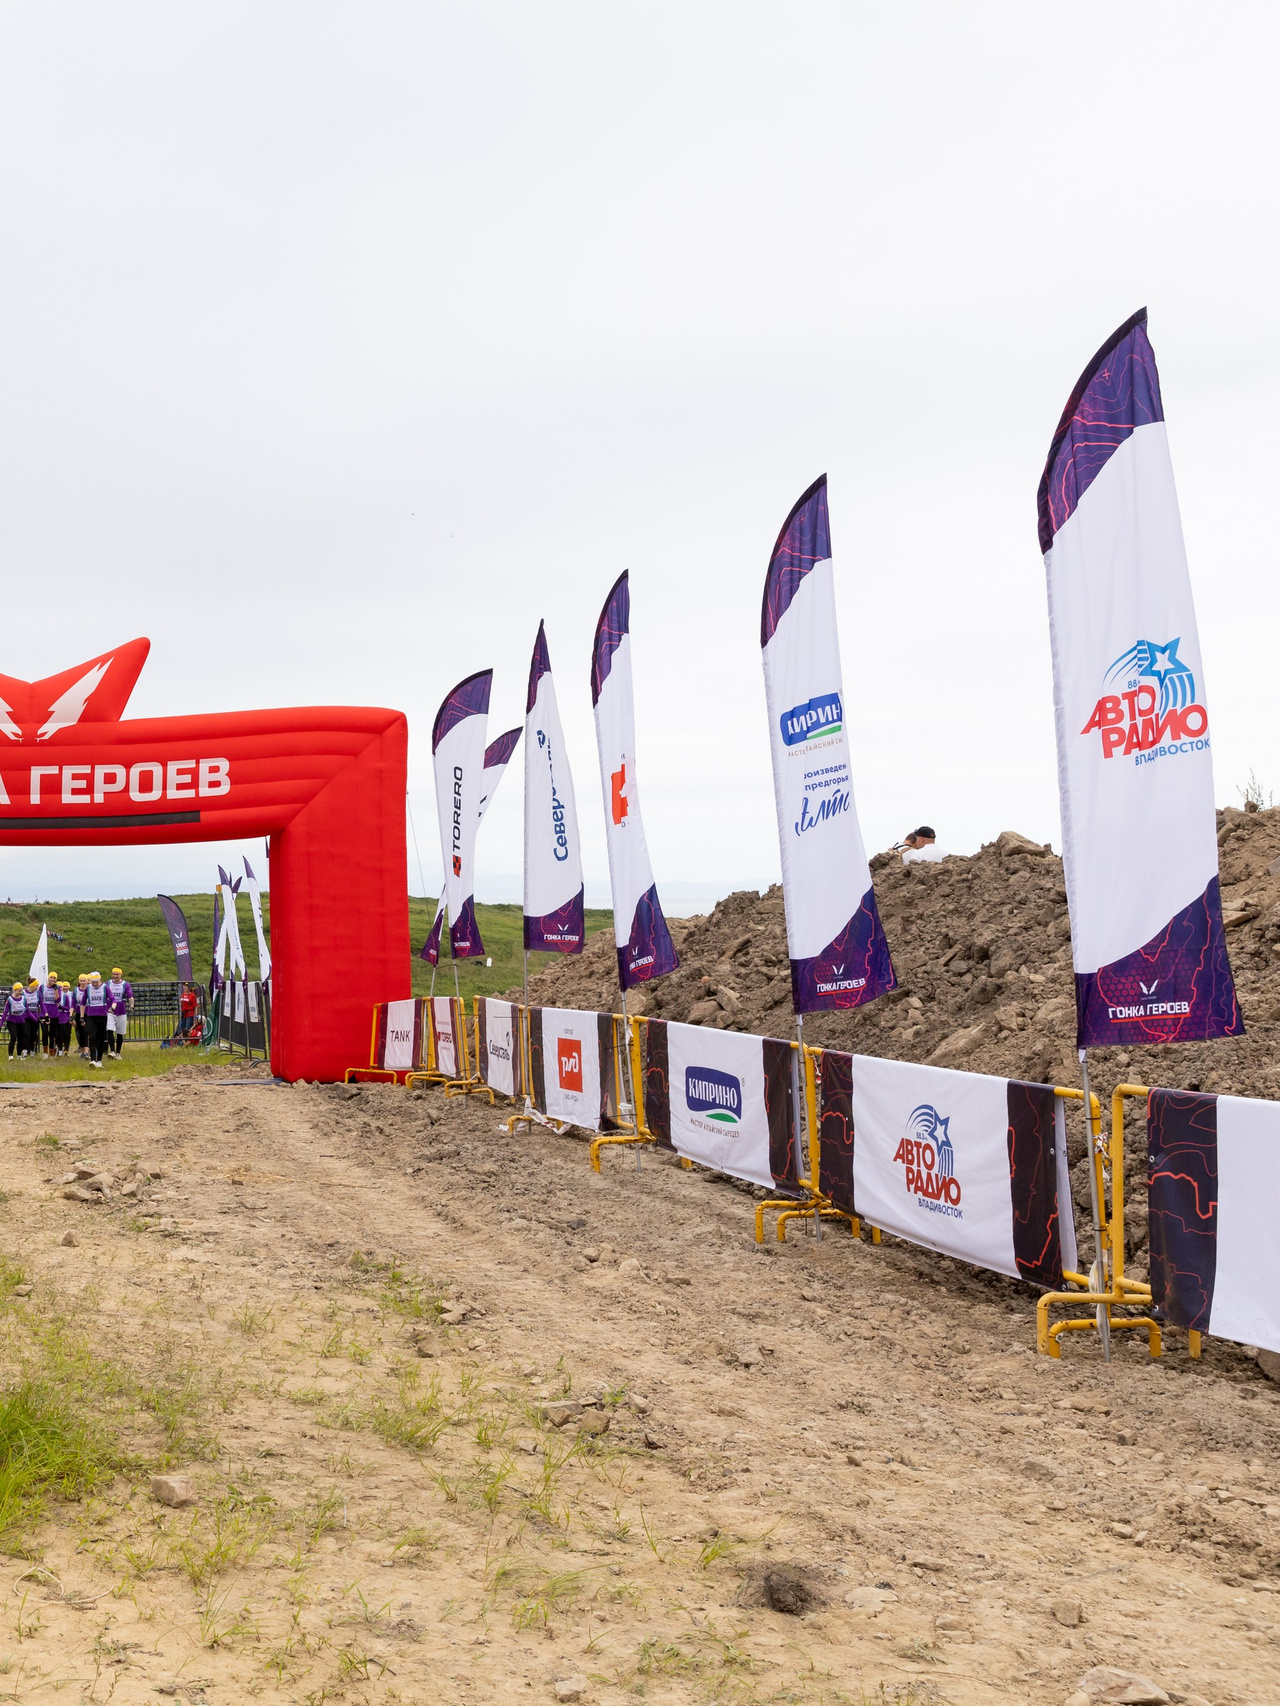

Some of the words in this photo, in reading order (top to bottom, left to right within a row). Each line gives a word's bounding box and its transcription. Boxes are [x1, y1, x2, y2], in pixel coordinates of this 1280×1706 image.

[1080, 684, 1157, 735] АВТО
[1101, 704, 1208, 759] РАДИО
[1135, 738, 1211, 766] ВЛАДИВОСТОК
[30, 756, 231, 805] ГЕРОЕВ
[452, 766, 463, 852] TORERO
[817, 982, 836, 992] ГОНКА
[1108, 1005, 1145, 1018] ГОНКА
[1146, 1002, 1189, 1015] ГЕРОЕВ
[390, 1030, 411, 1042] TANK
[688, 1077, 738, 1109] КИПРИНО
[893, 1137, 935, 1171] АВТО
[906, 1165, 961, 1206] РАДИО
[918, 1197, 963, 1219] ВЛАДИВОСТОК
